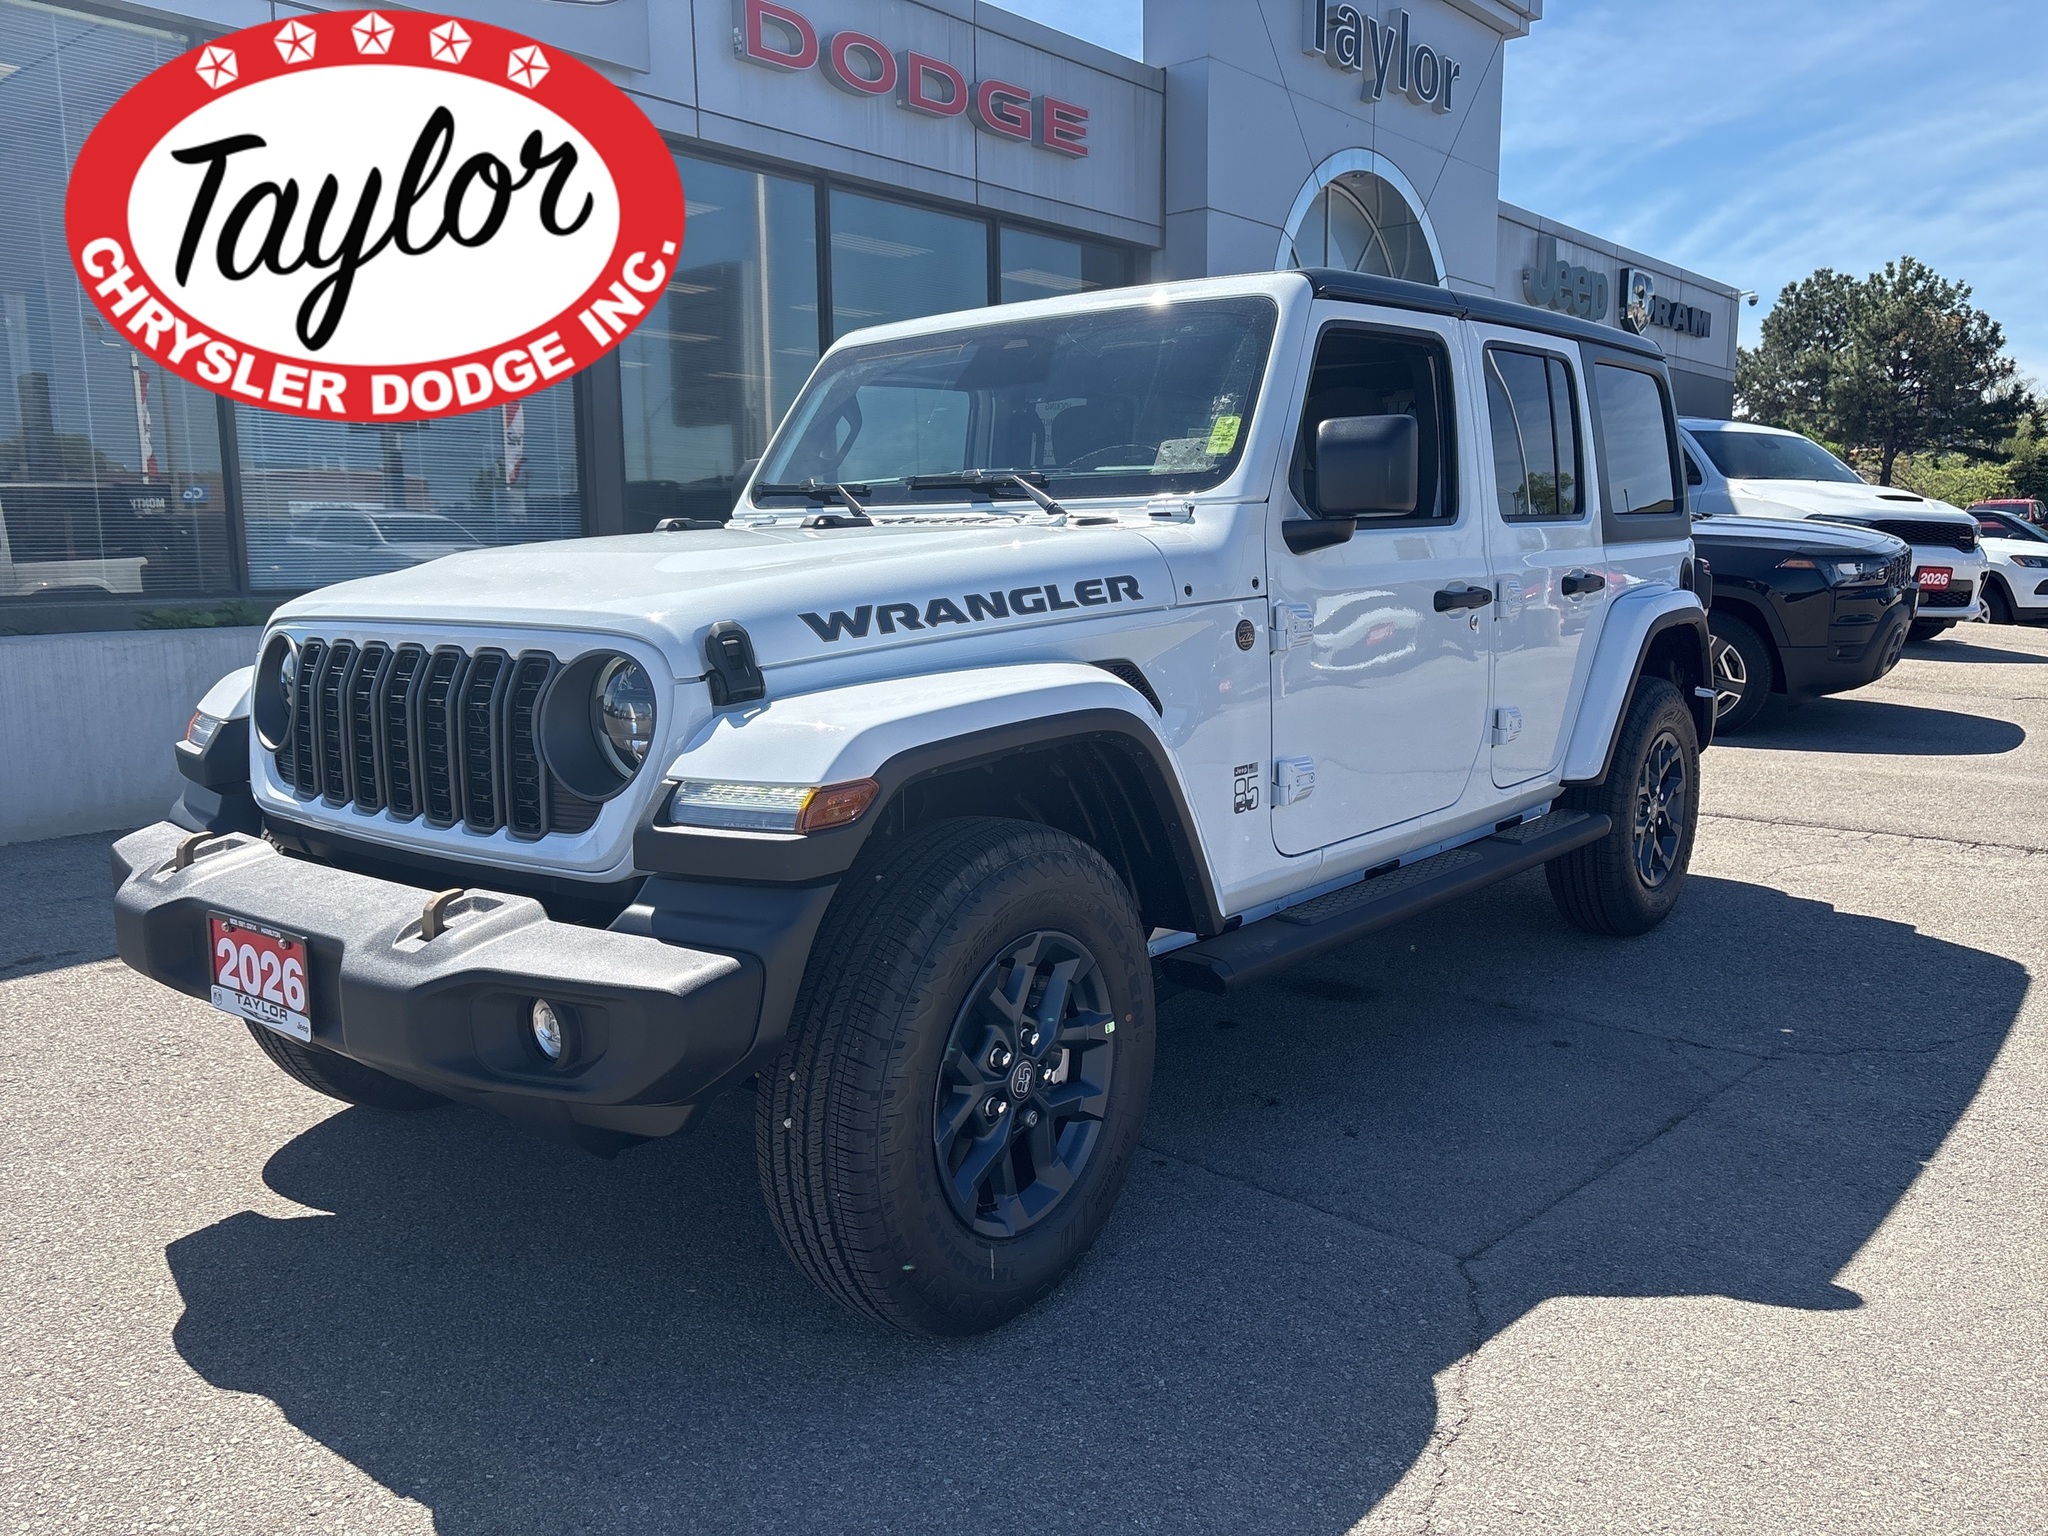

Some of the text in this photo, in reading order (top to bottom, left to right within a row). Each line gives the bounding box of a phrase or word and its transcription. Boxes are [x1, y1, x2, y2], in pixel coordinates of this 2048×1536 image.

[740, 0, 1090, 158] DODGE
[1525, 235, 1609, 321] Jeep
[1653, 295, 1711, 338] RAM
[797, 574, 1145, 643] WRANGLER
[1919, 572, 1949, 585] 2026
[1233, 774, 1259, 814] 85
[217, 937, 305, 1012] 2026
[1093, 898, 1145, 1031] NEXEN
[234, 992, 288, 1021] TAYLOR
